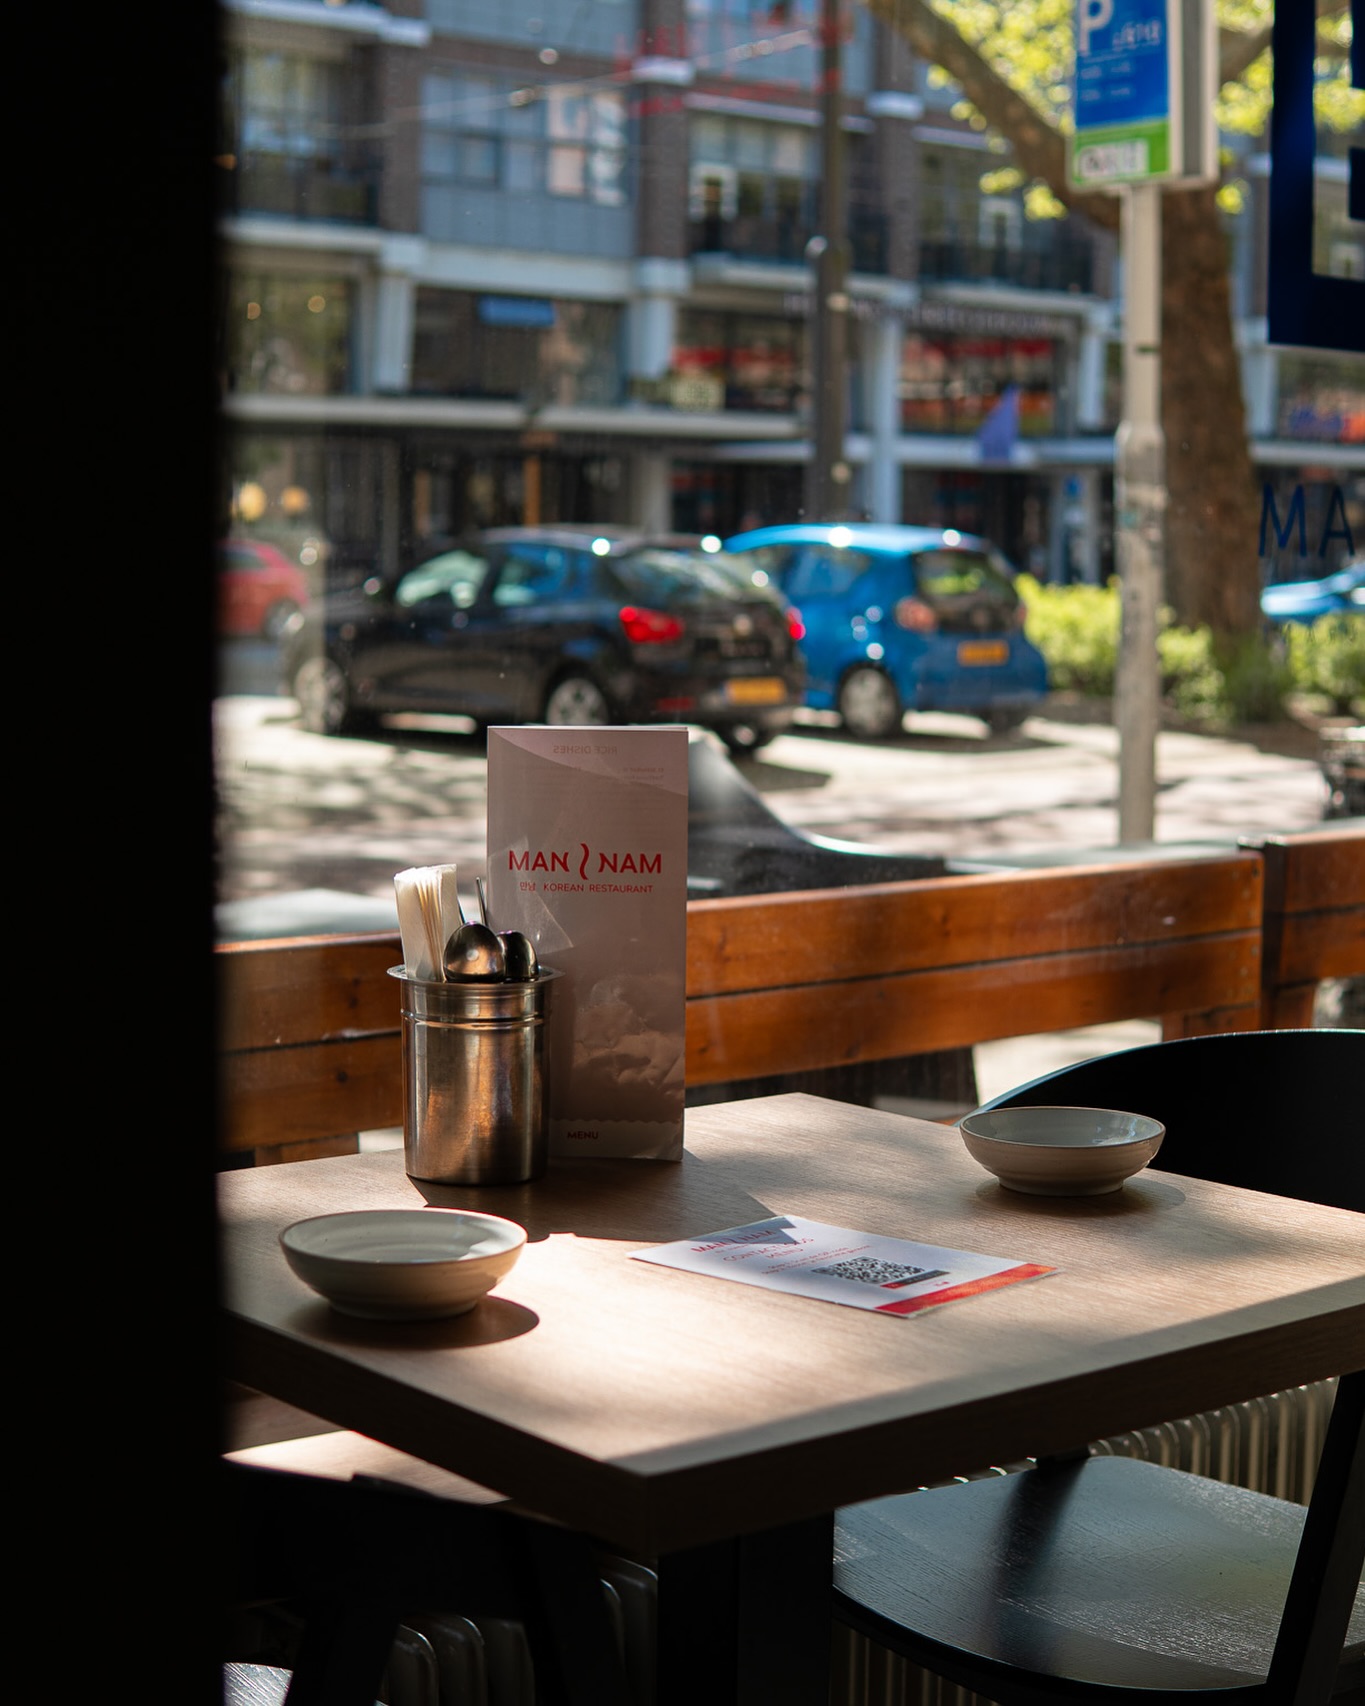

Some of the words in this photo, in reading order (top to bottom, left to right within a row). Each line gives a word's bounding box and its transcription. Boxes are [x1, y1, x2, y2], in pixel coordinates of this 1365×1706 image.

[1079, 0, 1114, 55] P
[508, 850, 570, 873] MAN
[597, 852, 662, 874] NAM
[543, 882, 585, 893] KOREAN
[589, 883, 654, 894] RESTAURANT
[567, 1130, 599, 1140] MENU
